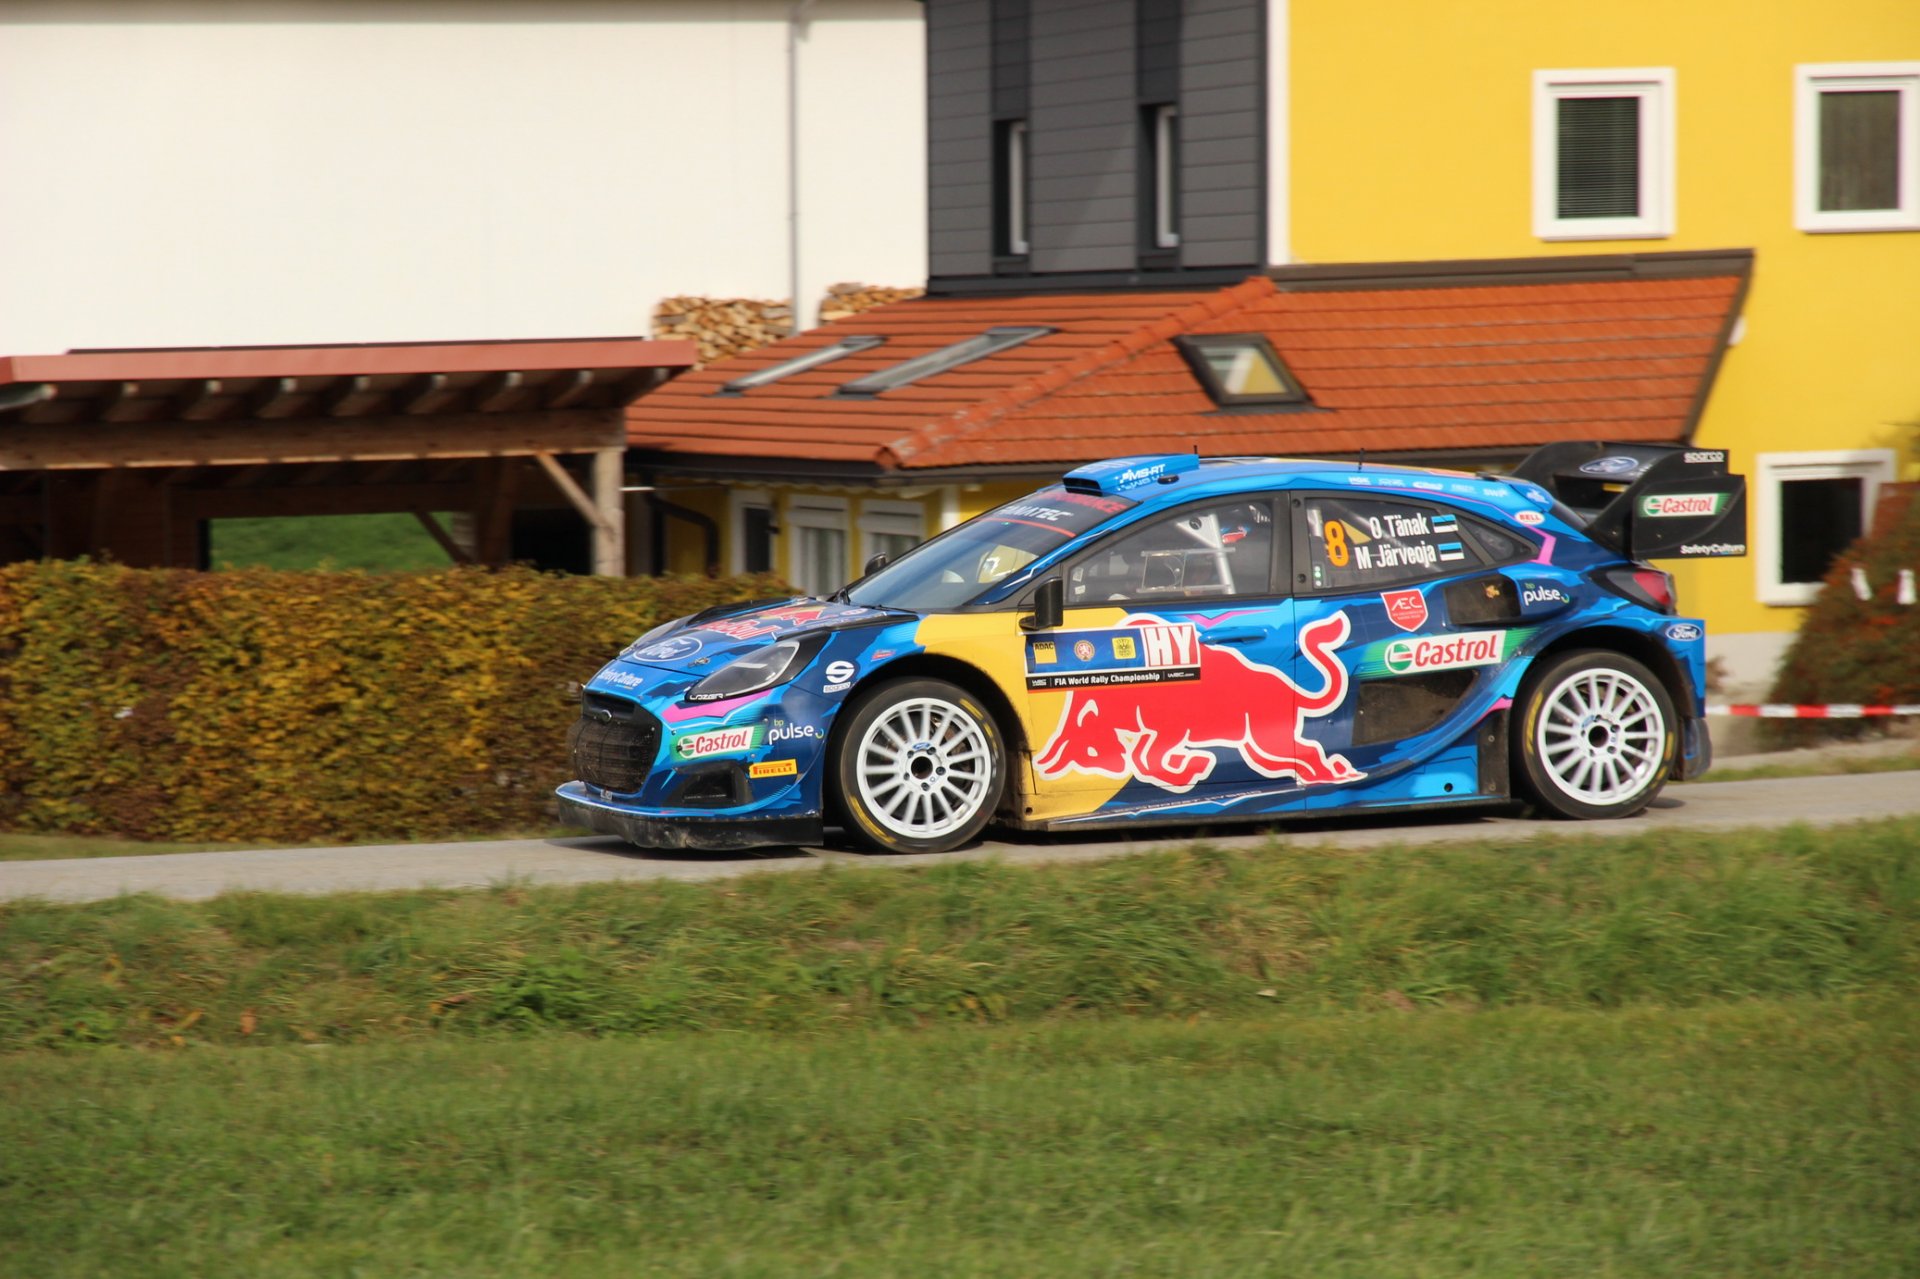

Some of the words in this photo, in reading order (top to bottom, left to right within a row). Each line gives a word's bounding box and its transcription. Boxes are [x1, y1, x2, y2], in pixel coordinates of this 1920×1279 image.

[1663, 498, 1713, 513] Castrol
[1385, 513, 1430, 537] Tänak
[1324, 520, 1349, 567] 8
[1354, 546, 1372, 570] M
[1377, 541, 1437, 569] Järveoja
[1524, 586, 1561, 606] pulse
[1034, 642, 1054, 650] ADAC
[1144, 625, 1196, 668] HY
[1415, 635, 1498, 667] Castrol
[1054, 677, 1067, 686] FIA
[1067, 675, 1089, 685] World
[1090, 674, 1109, 685] Rally
[1110, 672, 1160, 683] Championship
[769, 723, 815, 745] pulse
[774, 719, 784, 727] bp
[696, 730, 748, 754] Castrol
[753, 763, 793, 776] PIRELLI
